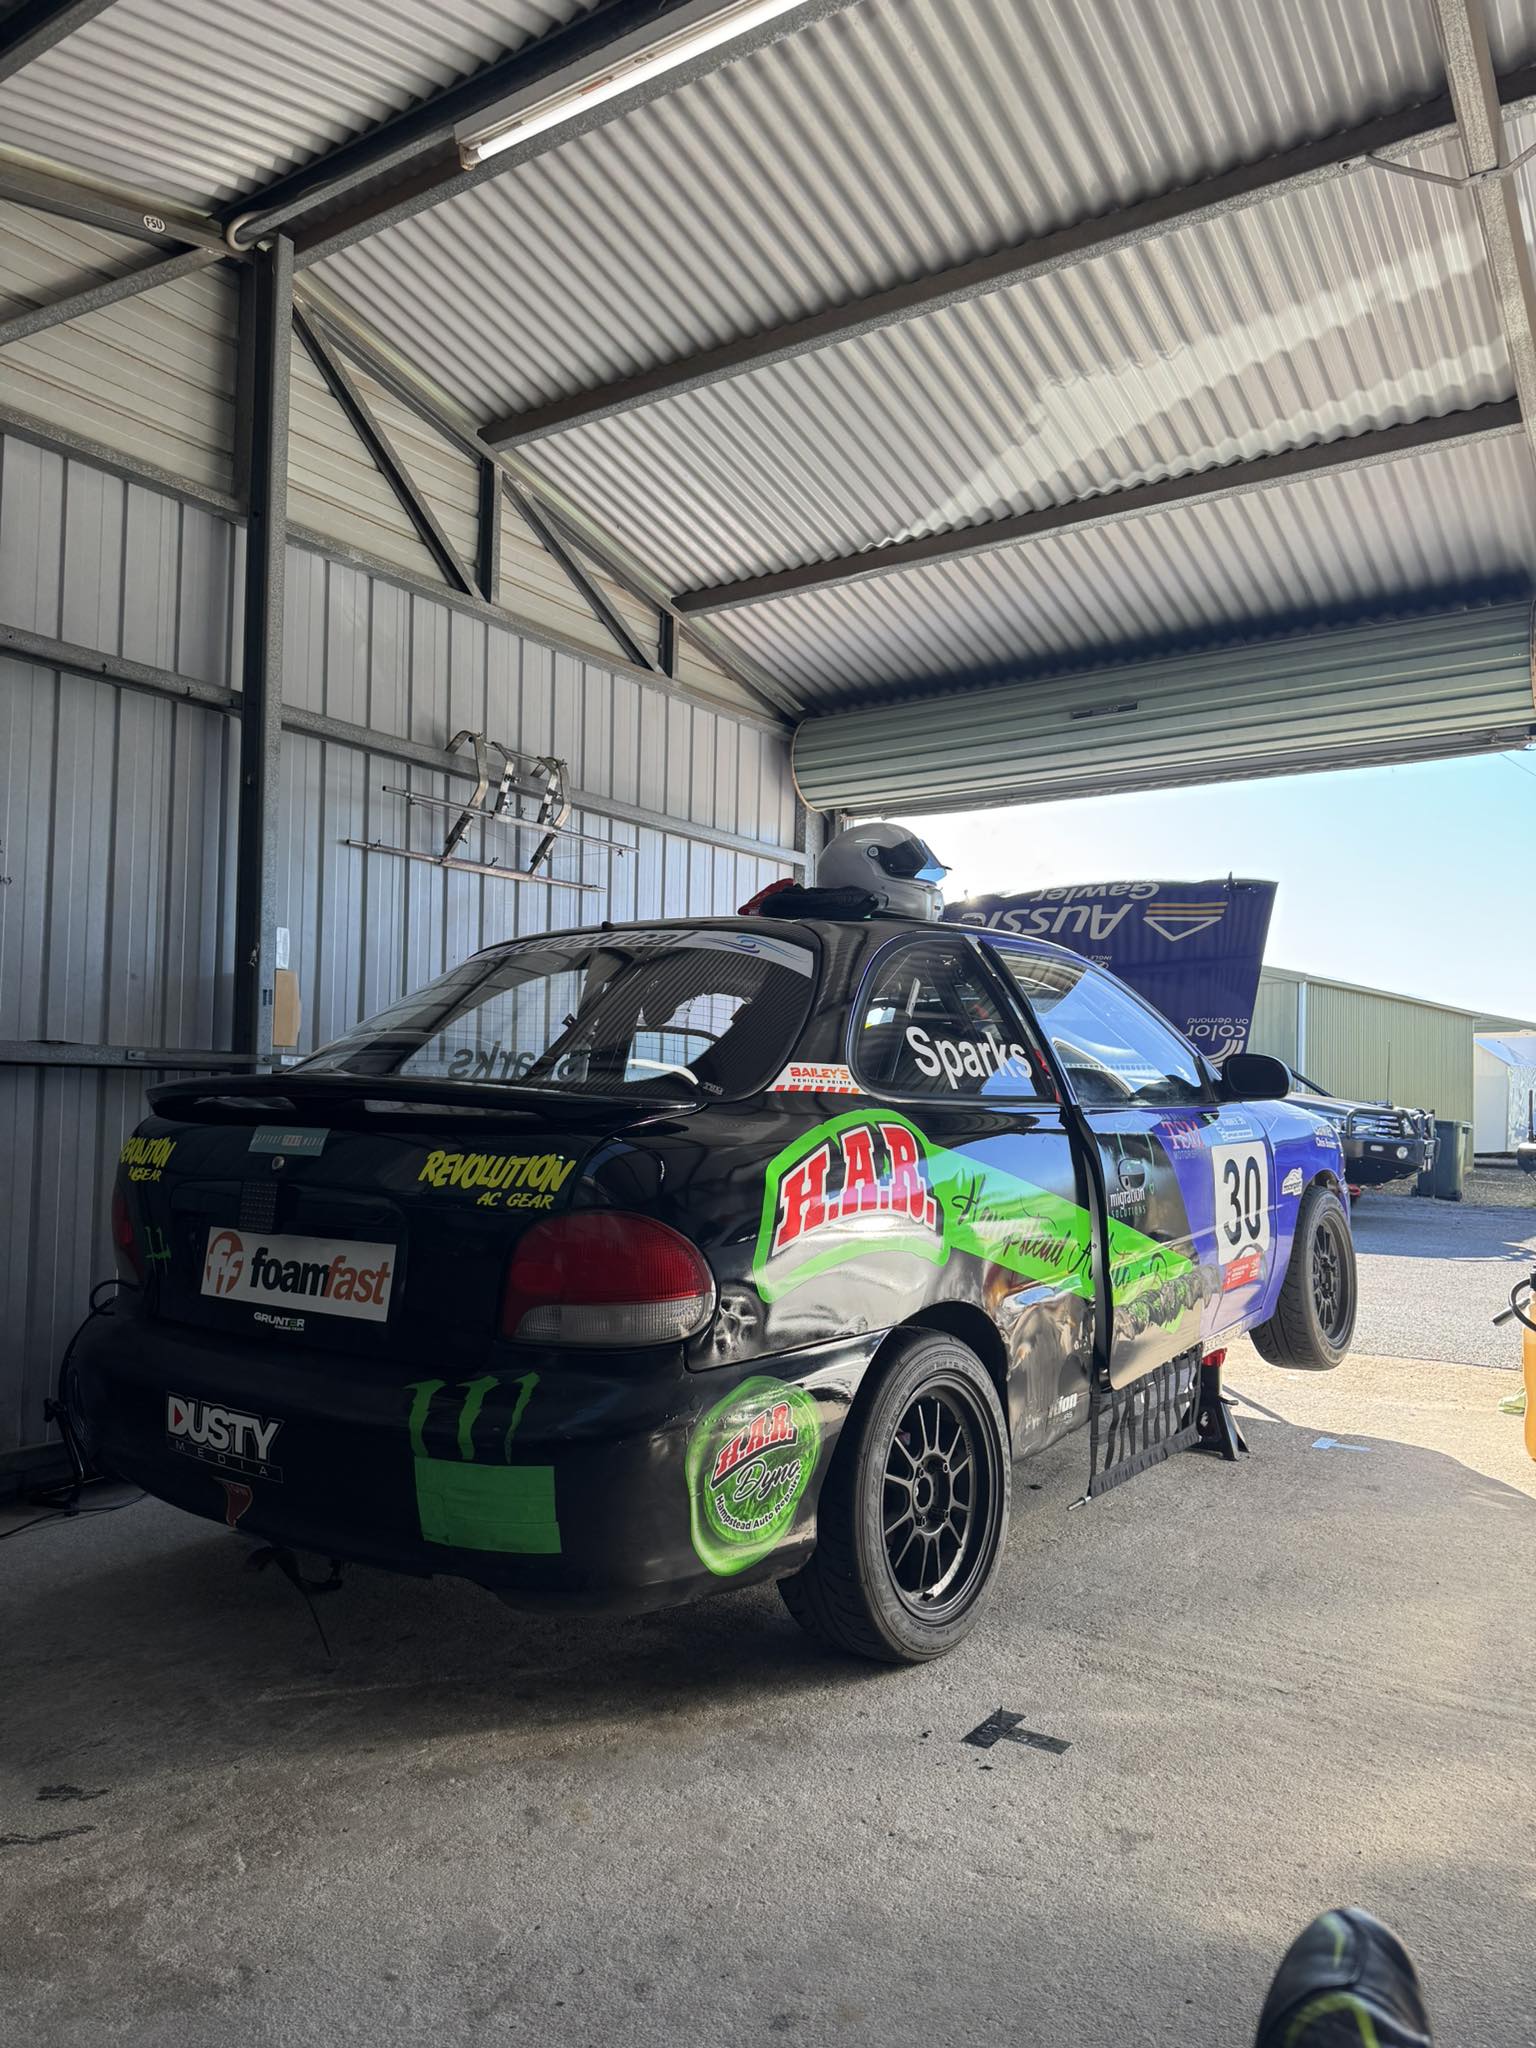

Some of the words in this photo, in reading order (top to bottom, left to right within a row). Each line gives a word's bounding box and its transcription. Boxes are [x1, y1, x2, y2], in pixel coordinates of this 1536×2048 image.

[1030, 881, 1160, 904] Gawler
[1186, 1024, 1246, 1041] color
[1187, 1017, 1232, 1025] demand
[789, 1066, 850, 1079] BAILEY'S
[905, 1026, 1033, 1090] Sparks
[418, 1150, 577, 1192] REVOLUTION
[771, 1123, 937, 1257] H.A.R.
[476, 1191, 502, 1206] AC
[506, 1192, 555, 1210] GEAR
[1110, 1187, 1146, 1209] migration
[1223, 1156, 1262, 1246] 30
[250, 1246, 391, 1305] foamfast
[253, 1311, 305, 1327] GRUNTER
[168, 1396, 279, 1460] DUSTY
[712, 1402, 796, 1483] H.A.R.
[175, 1440, 269, 1477] MEDIA
[733, 1459, 802, 1501] Dyno
[715, 1493, 751, 1531] Hampstead
[752, 1512, 774, 1530] Auto
[774, 1475, 801, 1514] Repairs
